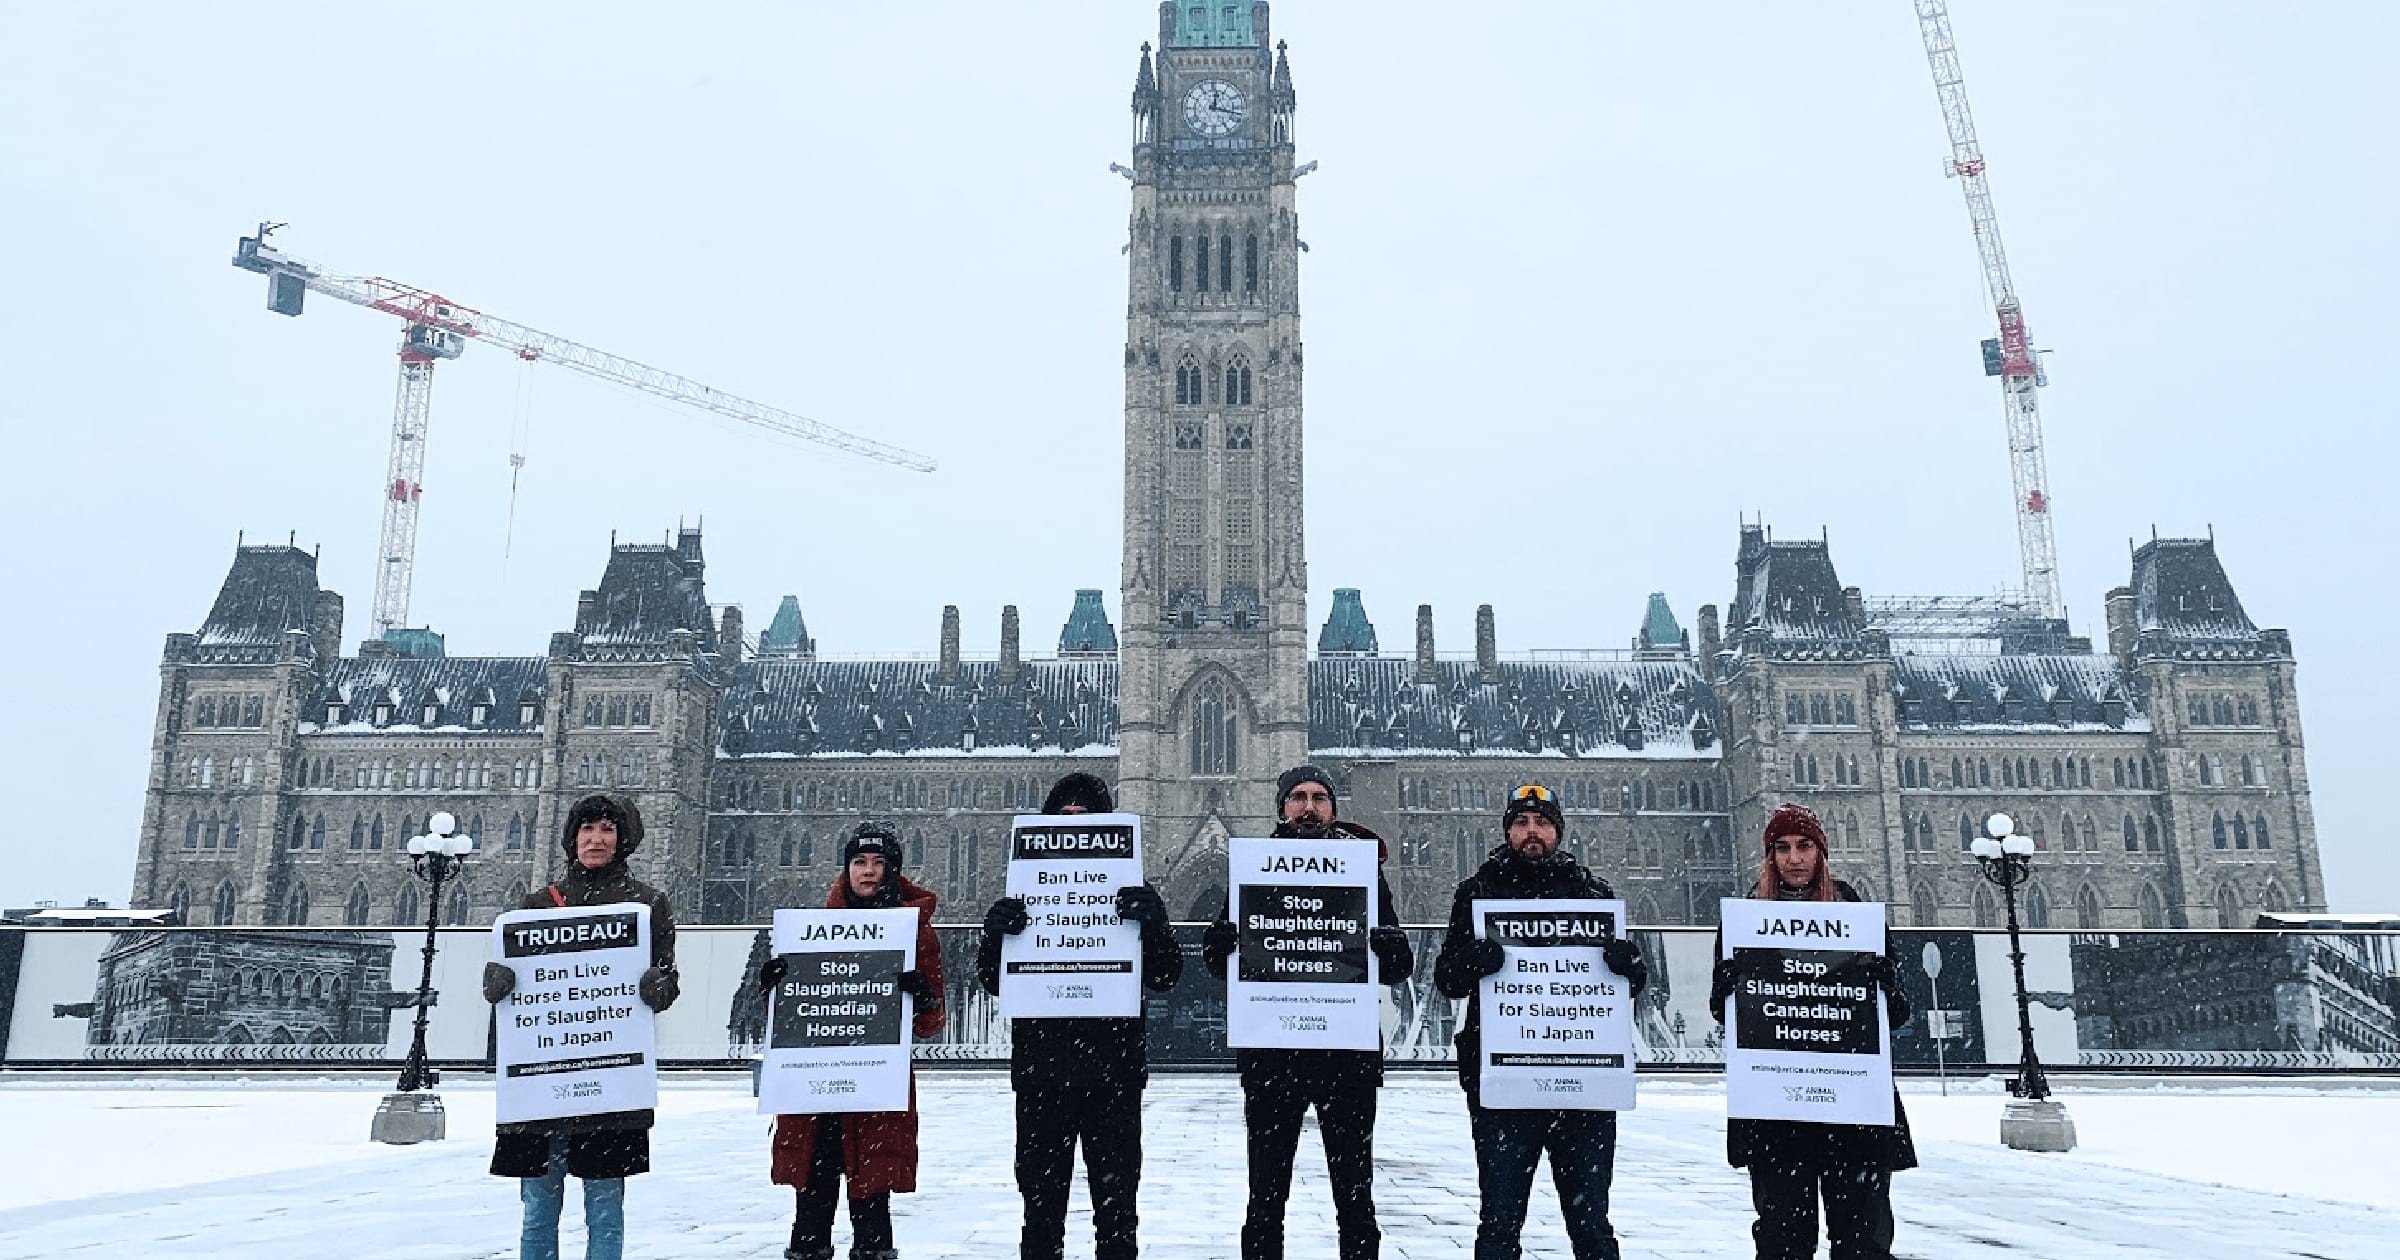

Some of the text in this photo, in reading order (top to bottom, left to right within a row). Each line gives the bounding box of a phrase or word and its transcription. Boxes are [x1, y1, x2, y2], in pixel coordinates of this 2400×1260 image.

[1021, 833, 1126, 850] TRUDEAU:
[1260, 856, 1346, 874] JAPAN:
[1038, 870, 1108, 885] Ban Live
[1067, 891, 1117, 907] Expor
[1283, 895, 1324, 912] Stop
[1046, 912, 1124, 928] Slaughter
[1249, 915, 1357, 934] Slaughtering
[1494, 919, 1607, 938] TRUDEAU:
[1756, 918, 1851, 938] JAPAN:
[515, 921, 628, 948] TRUDEAU:
[800, 923, 885, 942] JAPAN:
[1036, 935, 1106, 949] In Japan
[1264, 936, 1344, 952] Canadian
[535, 963, 611, 983] Ban Live
[820, 961, 860, 978] Stop
[1274, 957, 1333, 973] Horses
[1517, 959, 1590, 973] Ban Live
[1783, 958, 1828, 977] Stop
[510, 983, 636, 1007] Horse Exports
[784, 978, 893, 998] Slaughtering
[1494, 981, 1615, 998] Horse Exports
[1746, 980, 1867, 1001] Slaughtering
[515, 1006, 633, 1028] for Slaughter
[797, 1001, 877, 1017] Canadian
[1499, 1003, 1614, 1020] for Slaughter
[1763, 1003, 1852, 1021] Canadian
[807, 1022, 866, 1037] Horses
[1520, 1026, 1594, 1041] In Japan
[1775, 1025, 1842, 1042] Horses
[538, 1030, 613, 1048] In Japan
